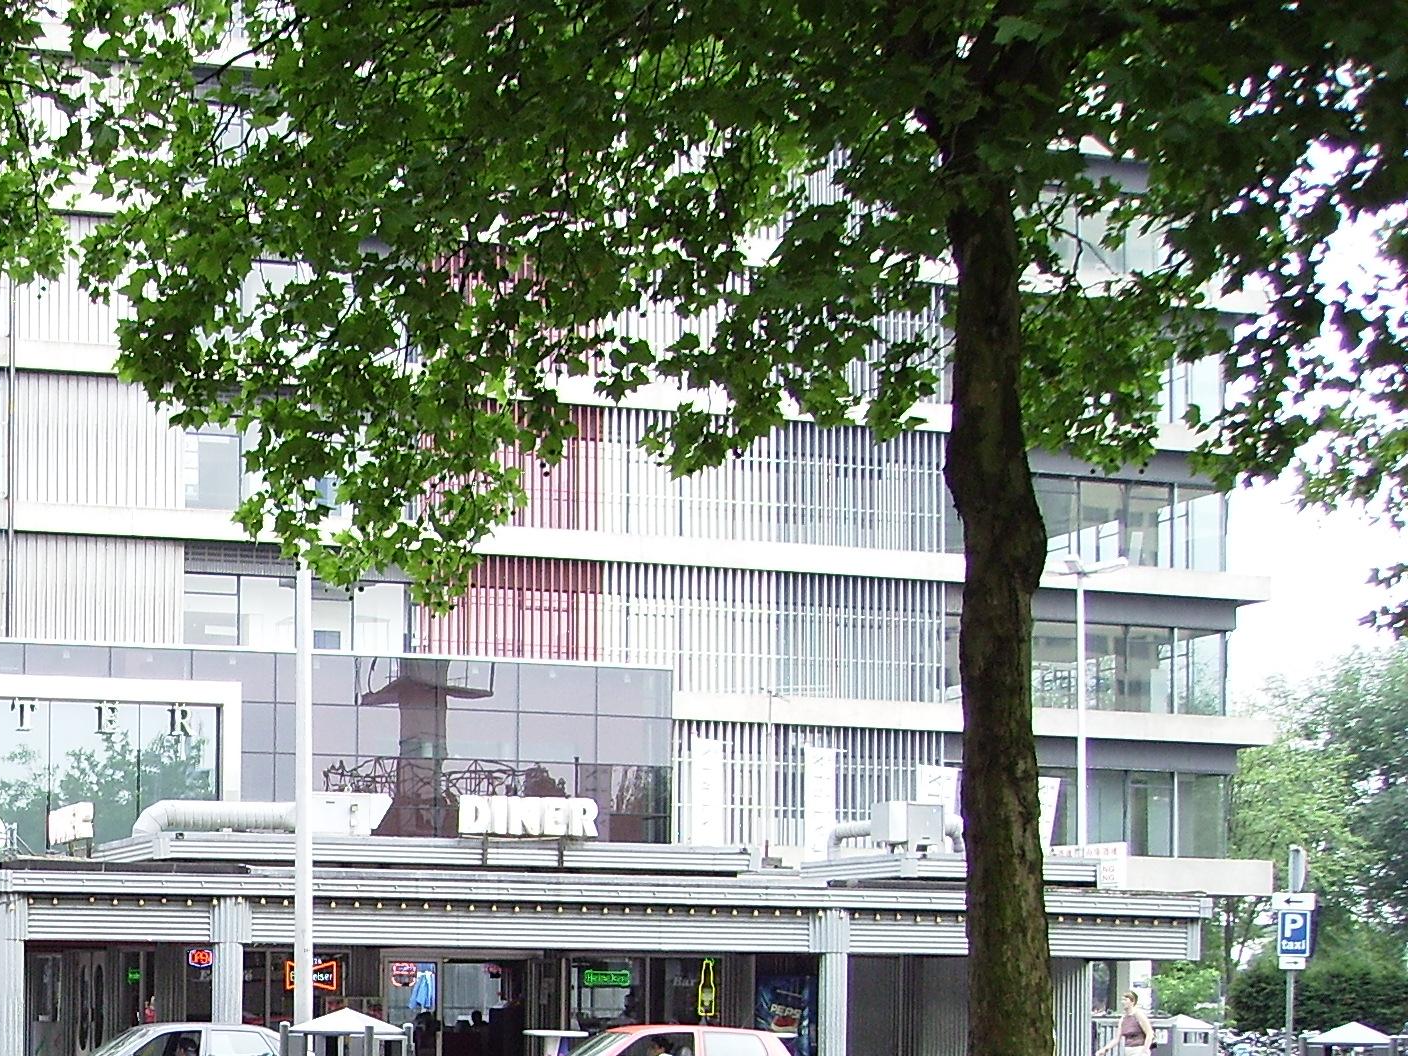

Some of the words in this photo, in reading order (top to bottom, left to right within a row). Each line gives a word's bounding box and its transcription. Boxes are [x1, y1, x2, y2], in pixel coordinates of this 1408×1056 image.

[458, 794, 599, 836] DINER
[1284, 913, 1304, 938] P
[1281, 939, 1306, 950] taxi
[673, 976, 697, 987] Bar
